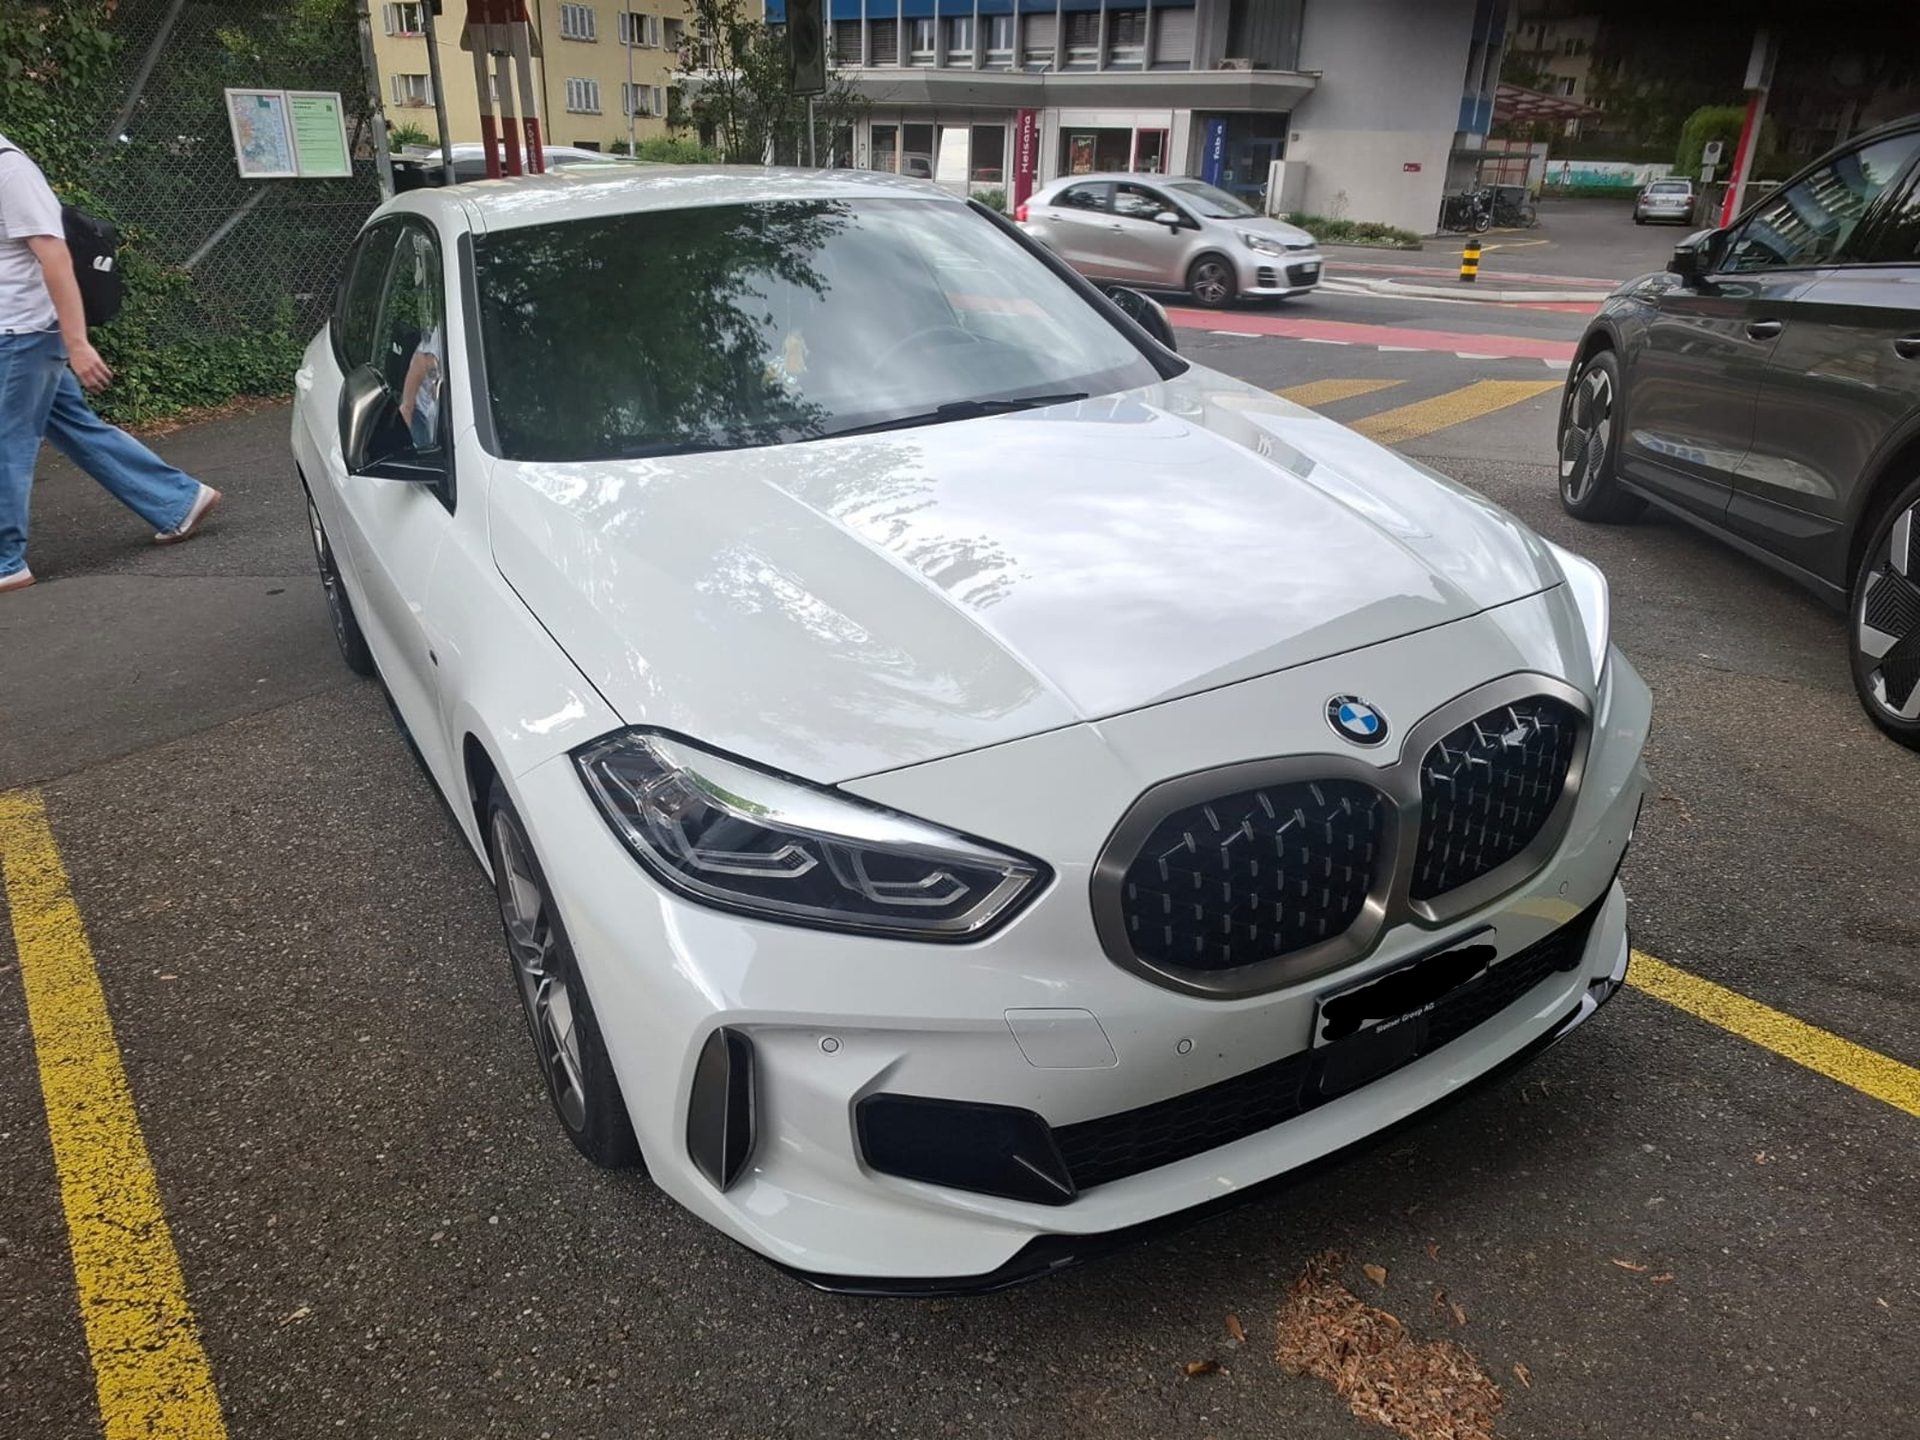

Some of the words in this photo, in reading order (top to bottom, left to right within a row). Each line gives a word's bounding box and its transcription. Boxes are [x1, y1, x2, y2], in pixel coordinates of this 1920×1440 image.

[1021, 115, 1031, 173] Helsana
[1402, 1008, 1423, 1022] Group
[1423, 1002, 1435, 1012] AG
